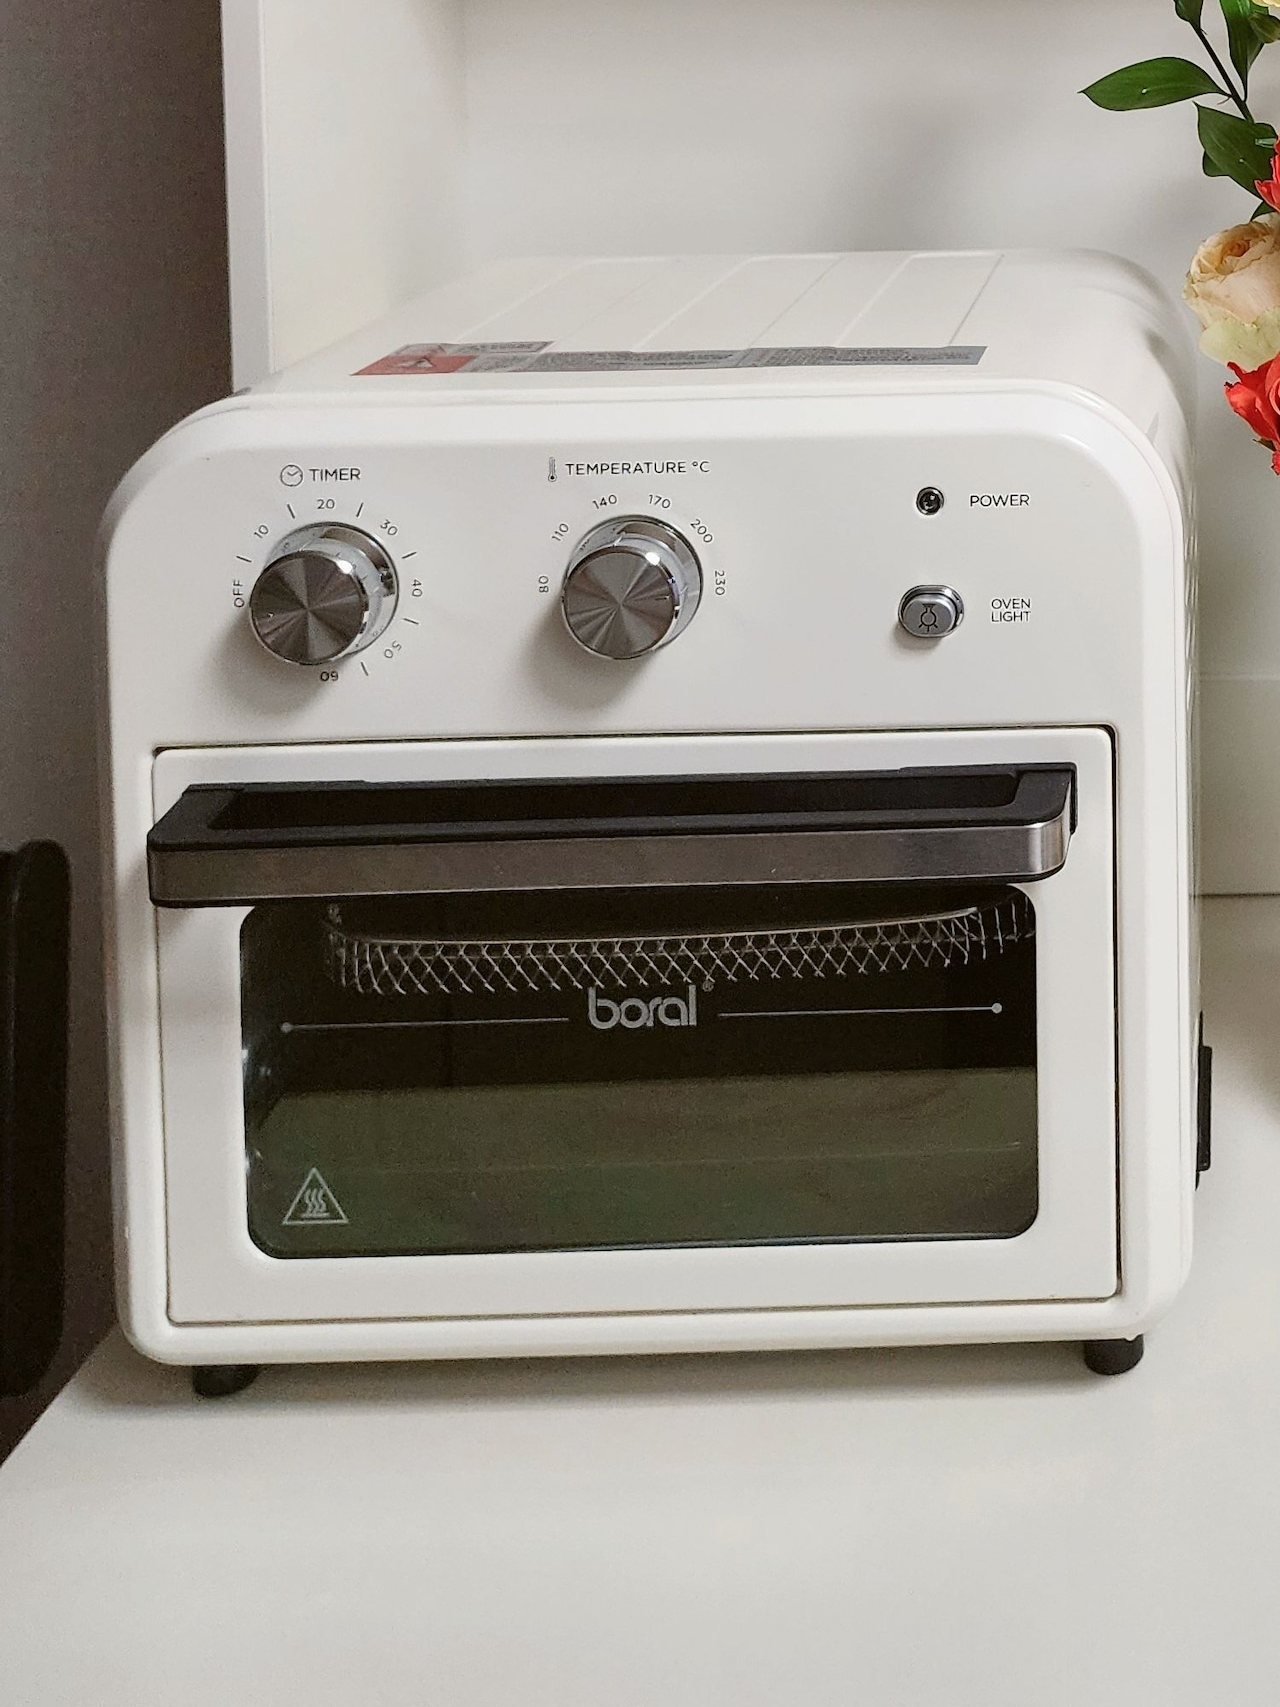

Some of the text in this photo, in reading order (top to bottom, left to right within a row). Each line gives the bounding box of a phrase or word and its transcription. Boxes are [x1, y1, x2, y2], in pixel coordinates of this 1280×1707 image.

[308, 468, 361, 482] TIMER
[565, 462, 686, 476] TEMPERATURE
[317, 498, 335, 510] 20
[592, 494, 618, 510] 140
[648, 494, 671, 509] 170
[970, 494, 1030, 507] POWER
[253, 524, 269, 539] 10
[380, 519, 398, 536] 30
[551, 523, 570, 542] 110
[690, 518, 713, 543] 200
[411, 578, 423, 598] 40
[538, 575, 549, 593] 80
[715, 570, 726, 596] 230
[233, 579, 245, 608] OFF
[991, 598, 1031, 610] OVEN
[991, 611, 1031, 623] LIGHT
[383, 640, 402, 659] 50
[587, 985, 697, 1030] boral
